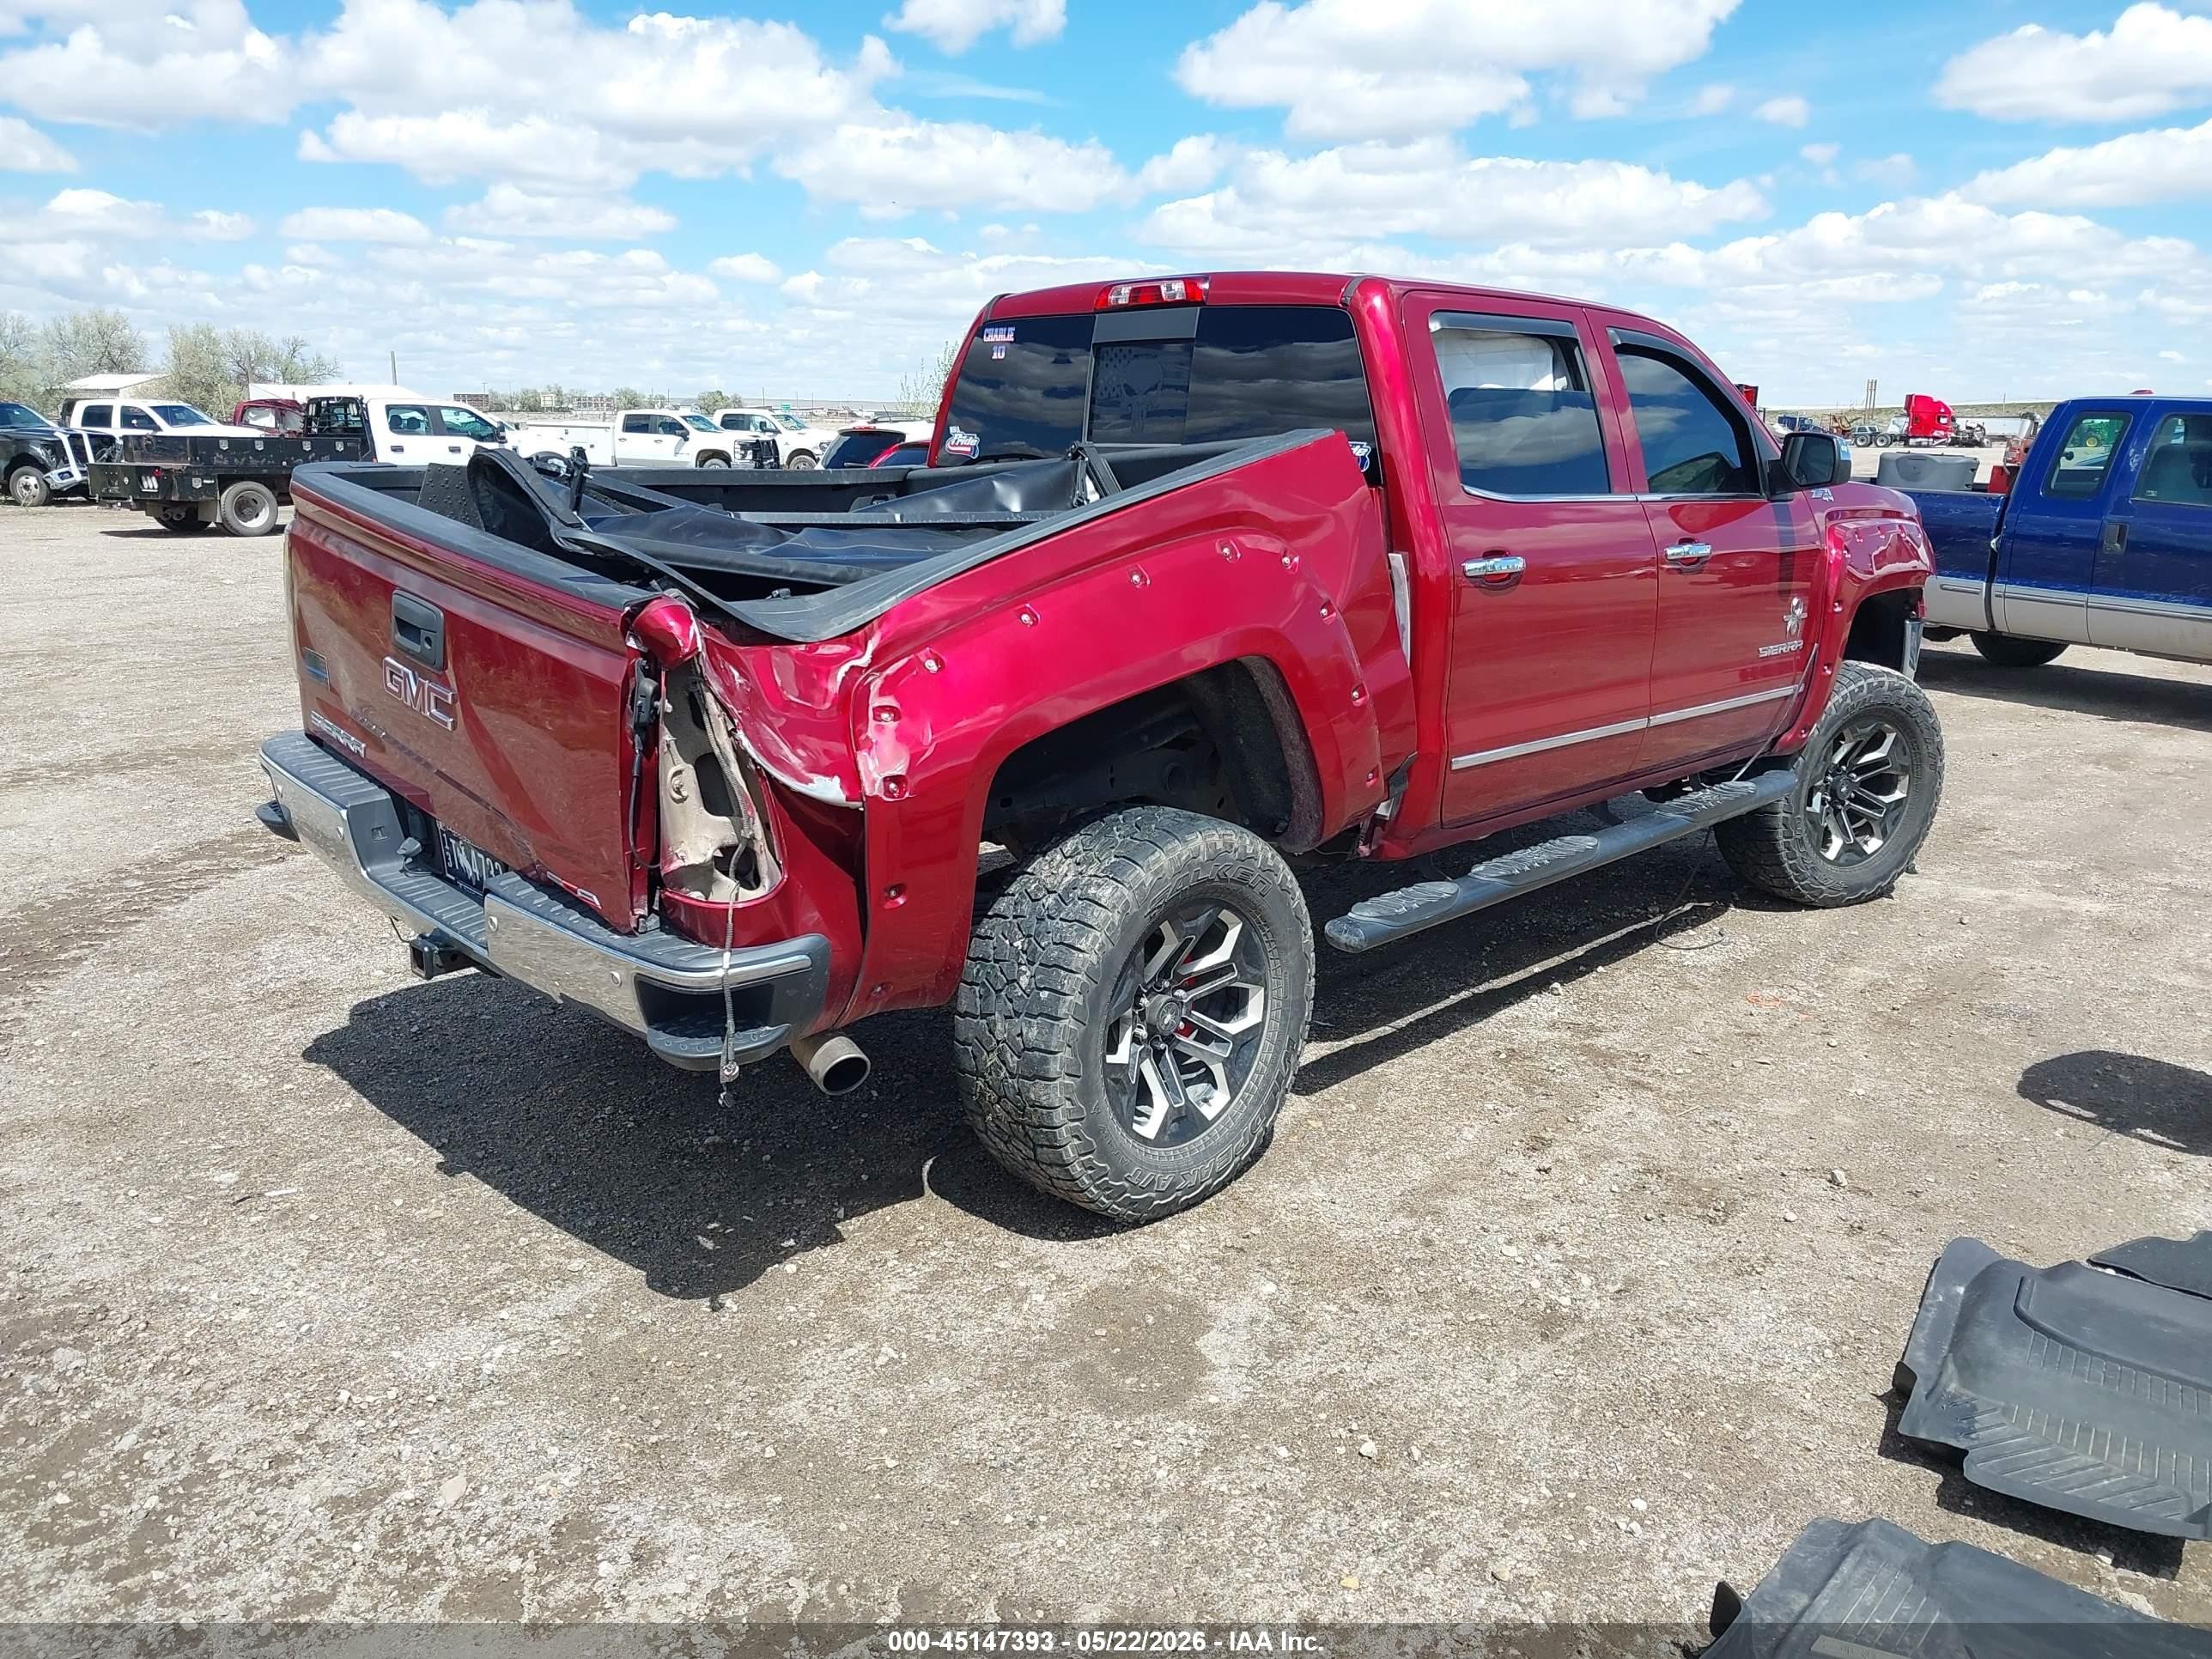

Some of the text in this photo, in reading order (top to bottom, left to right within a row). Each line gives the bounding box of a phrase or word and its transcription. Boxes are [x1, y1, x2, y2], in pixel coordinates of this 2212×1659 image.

[983, 326, 1016, 342] CHARLIE
[992, 345, 1006, 359] 10
[951, 434, 978, 446] Pride
[1758, 640, 1804, 659] SIERRA
[383, 656, 455, 731] GMC
[1175, 1034, 1297, 1193] WILDPEAK
